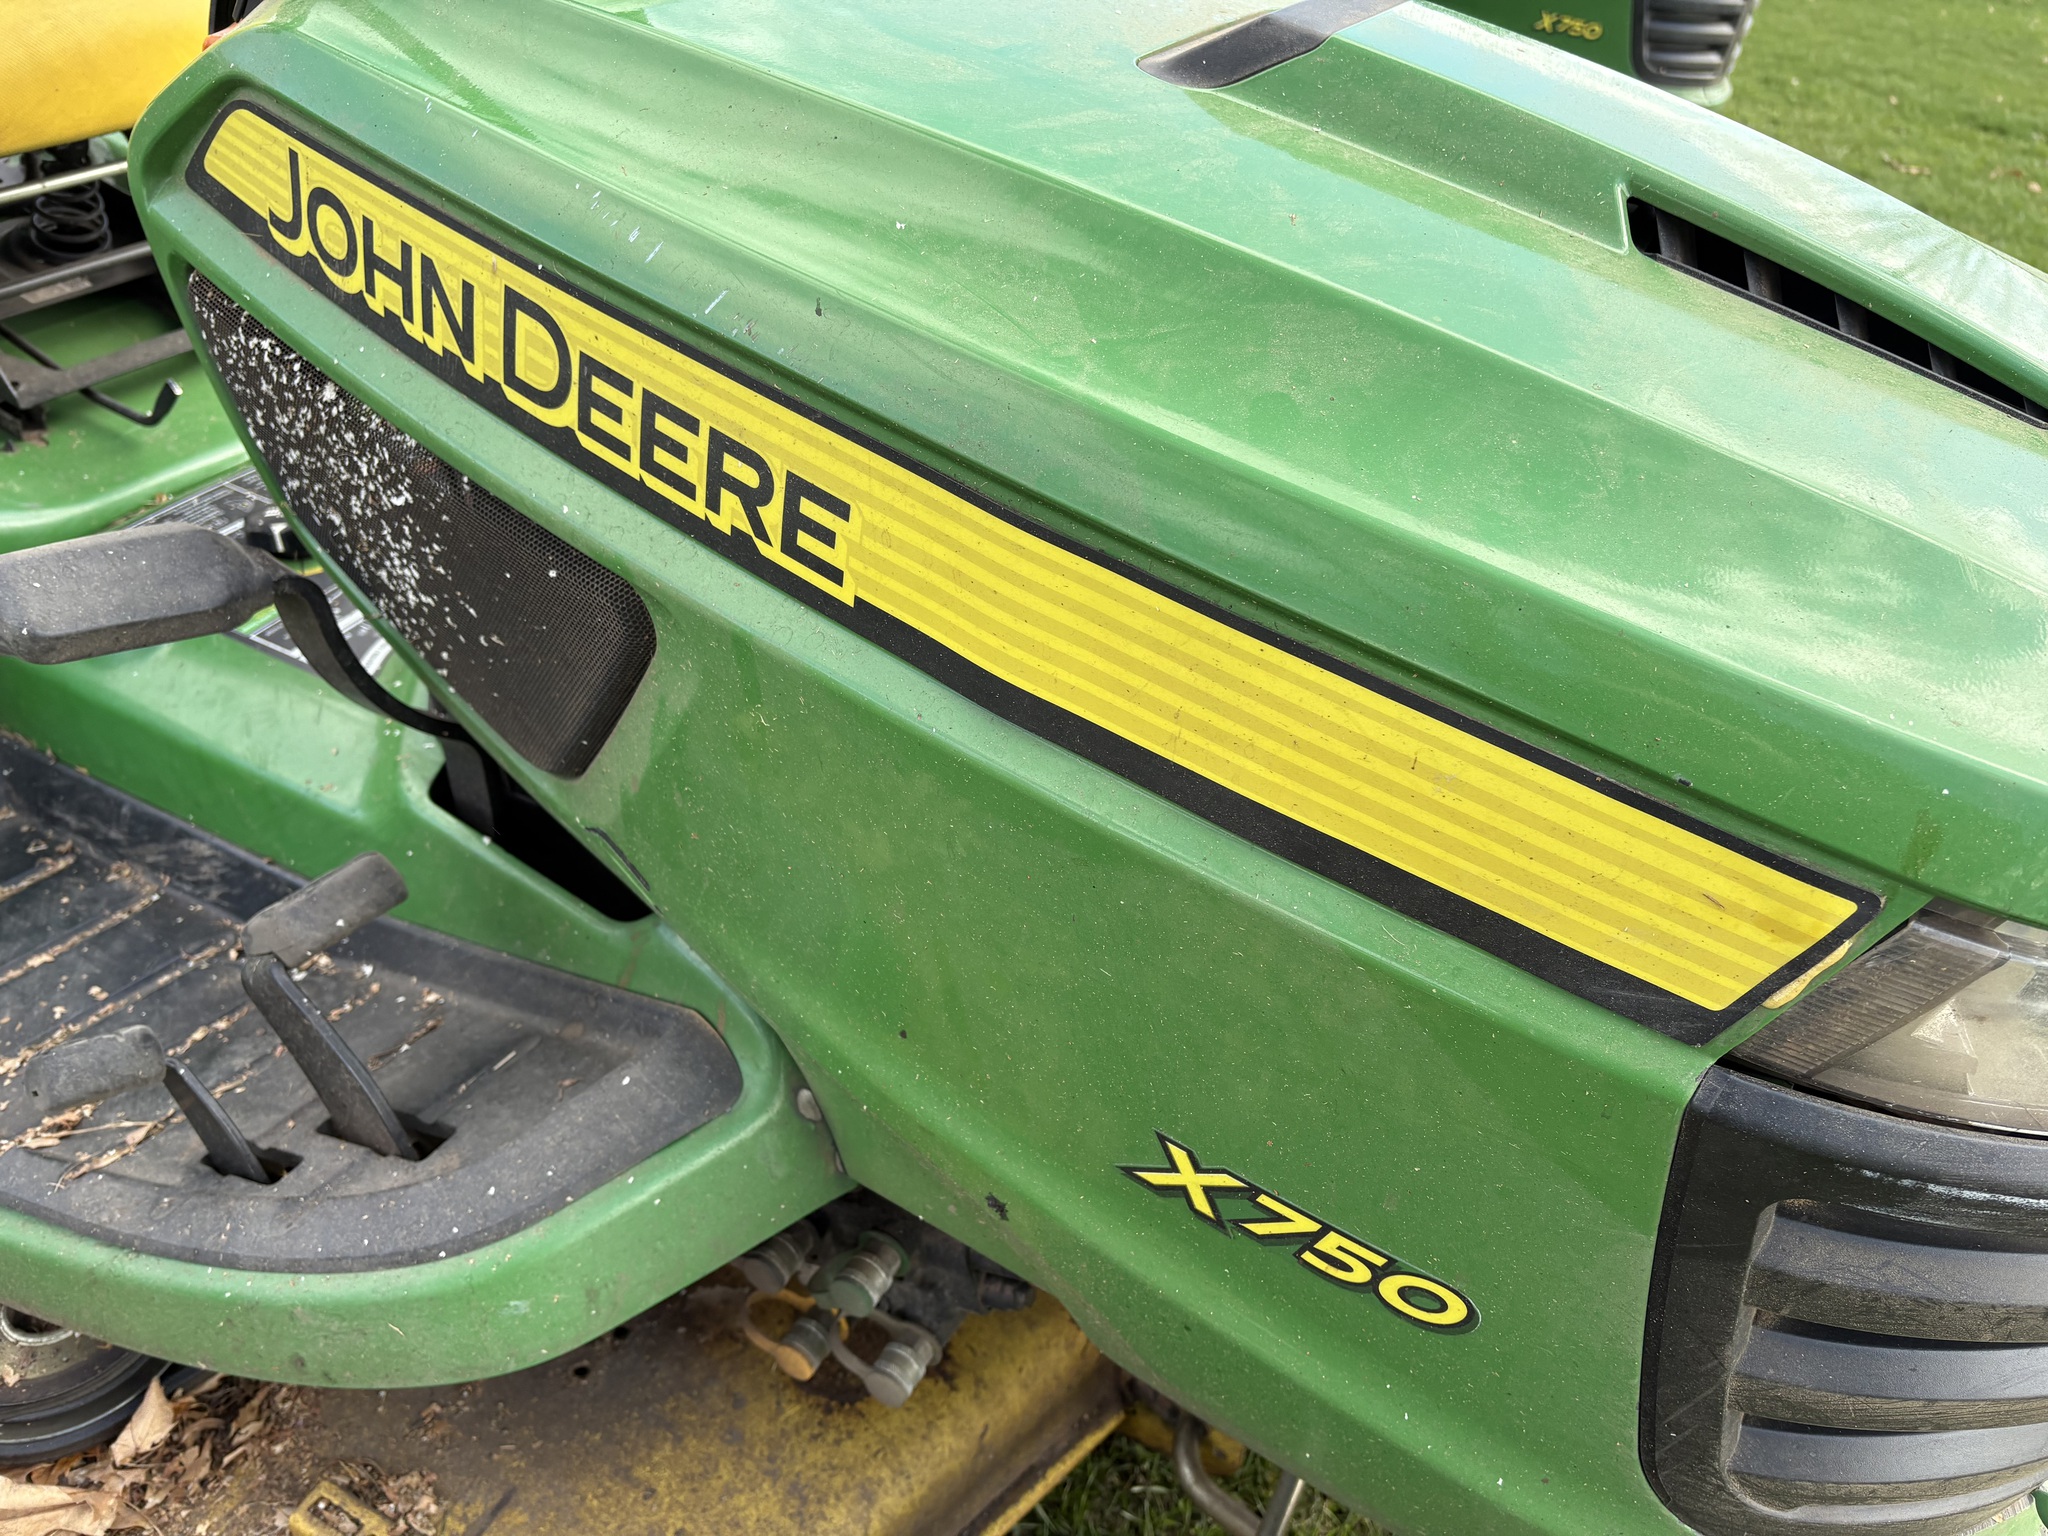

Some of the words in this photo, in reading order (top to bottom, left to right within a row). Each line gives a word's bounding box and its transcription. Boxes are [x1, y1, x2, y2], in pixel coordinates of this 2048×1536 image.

[1534, 11, 1604, 41] X750
[268, 147, 475, 365] JOHN
[503, 284, 852, 586] DEERE
[1129, 1136, 1471, 1328] X750
